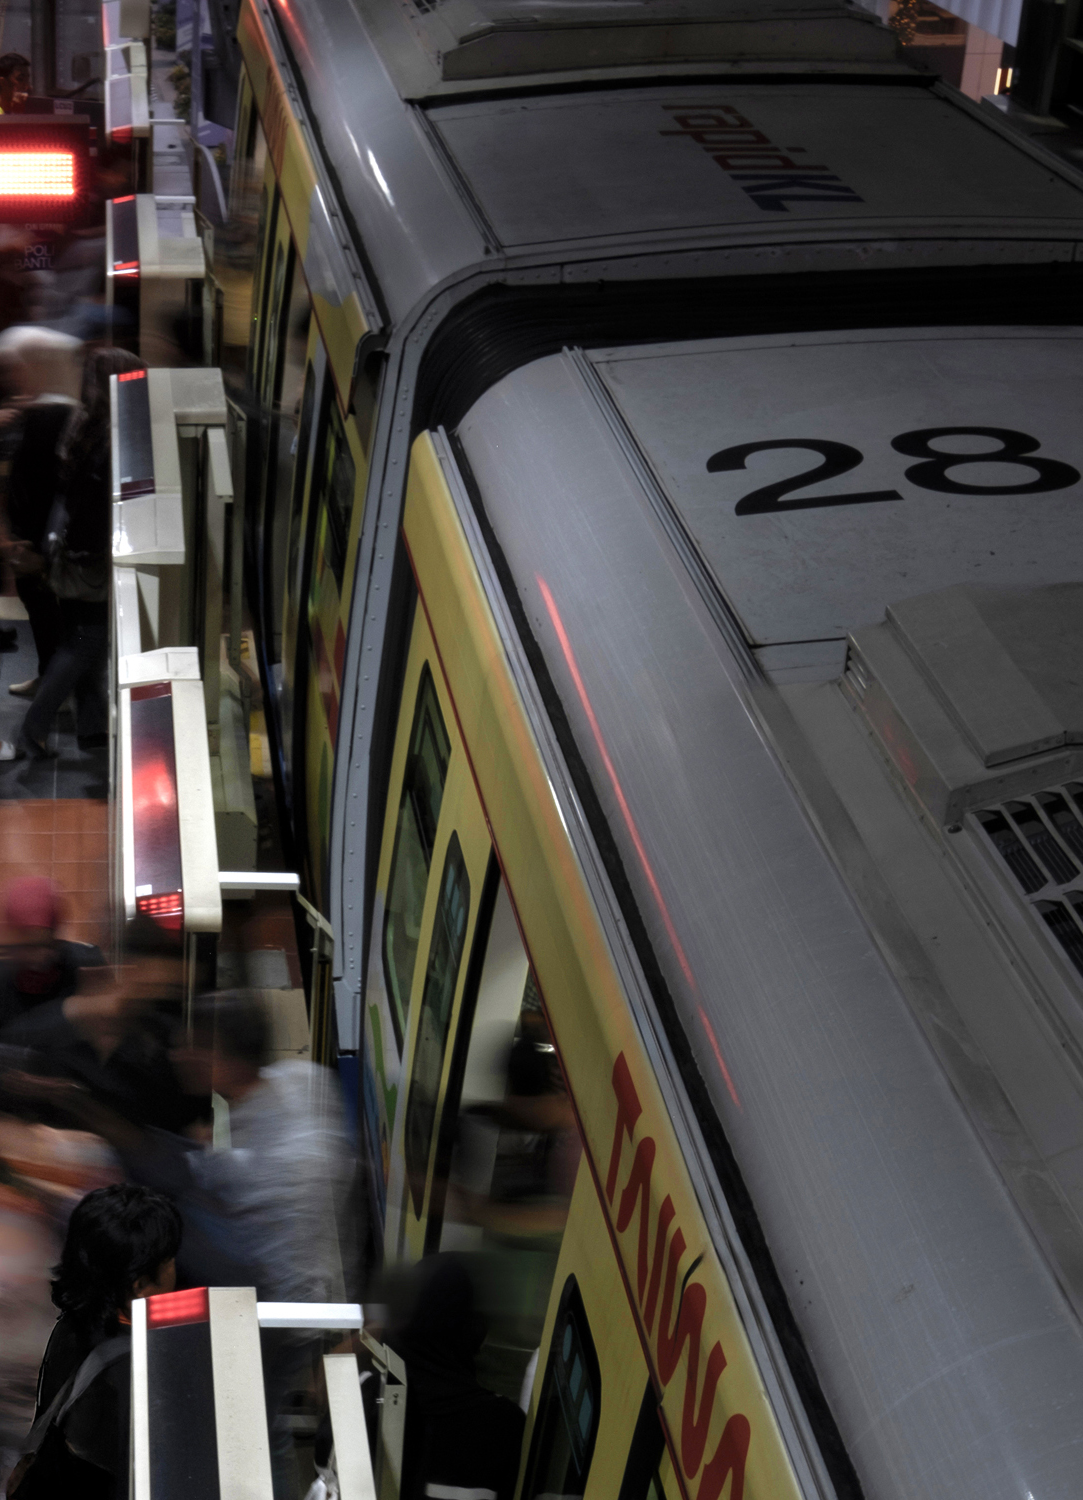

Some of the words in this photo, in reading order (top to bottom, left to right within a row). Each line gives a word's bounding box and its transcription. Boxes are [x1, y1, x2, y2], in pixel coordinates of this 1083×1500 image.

[659, 103, 865, 212] rapidKL
[24, 244, 56, 257] POLI
[706, 426, 1082, 516] 28
